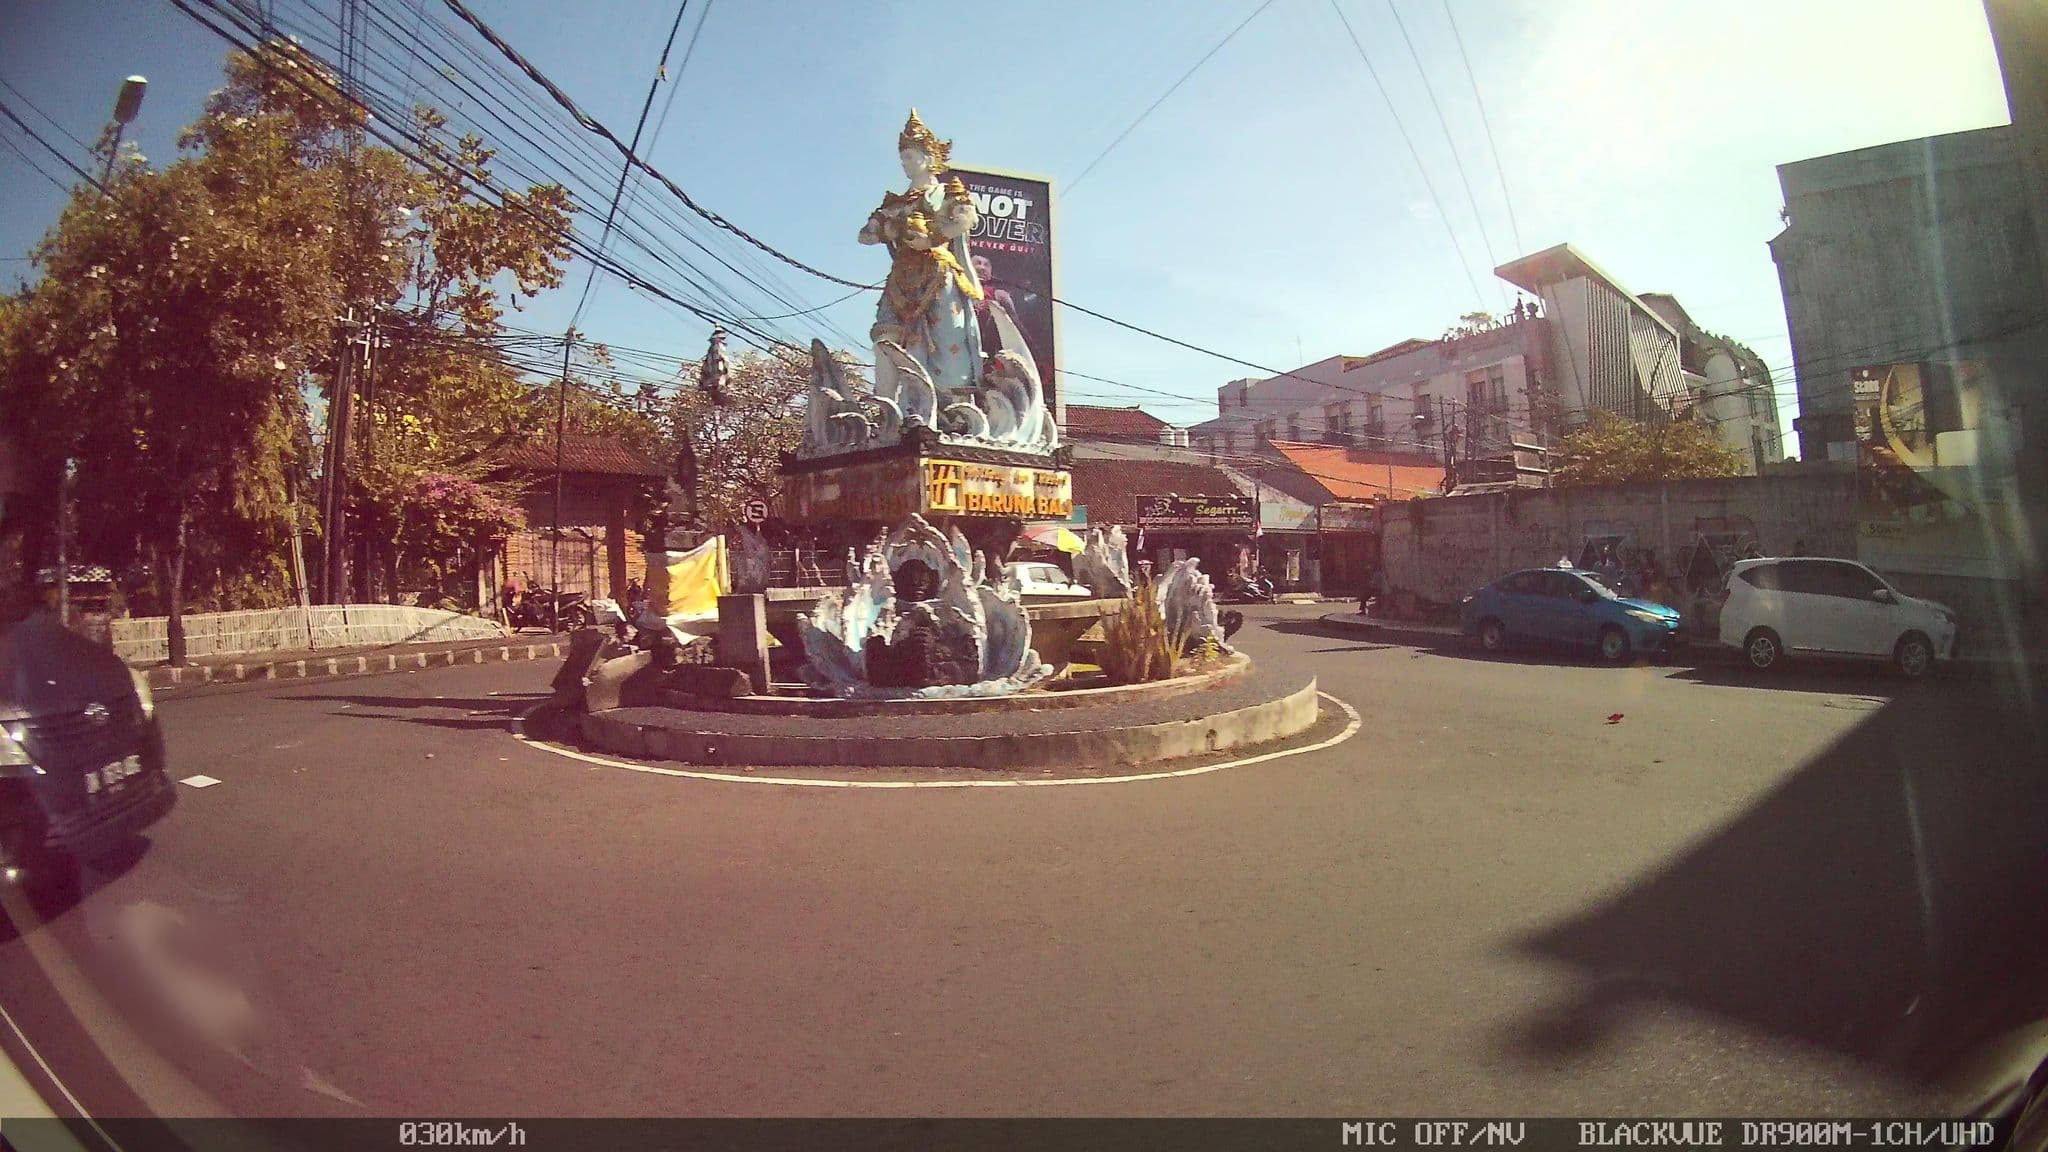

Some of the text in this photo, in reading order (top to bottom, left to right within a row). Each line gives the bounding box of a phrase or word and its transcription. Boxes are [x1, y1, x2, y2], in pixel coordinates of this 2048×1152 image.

[969, 184, 986, 192] THE
[988, 186, 1013, 195] GAME
[968, 192, 1033, 220] NOT
[965, 493, 1036, 514] BARUNA
